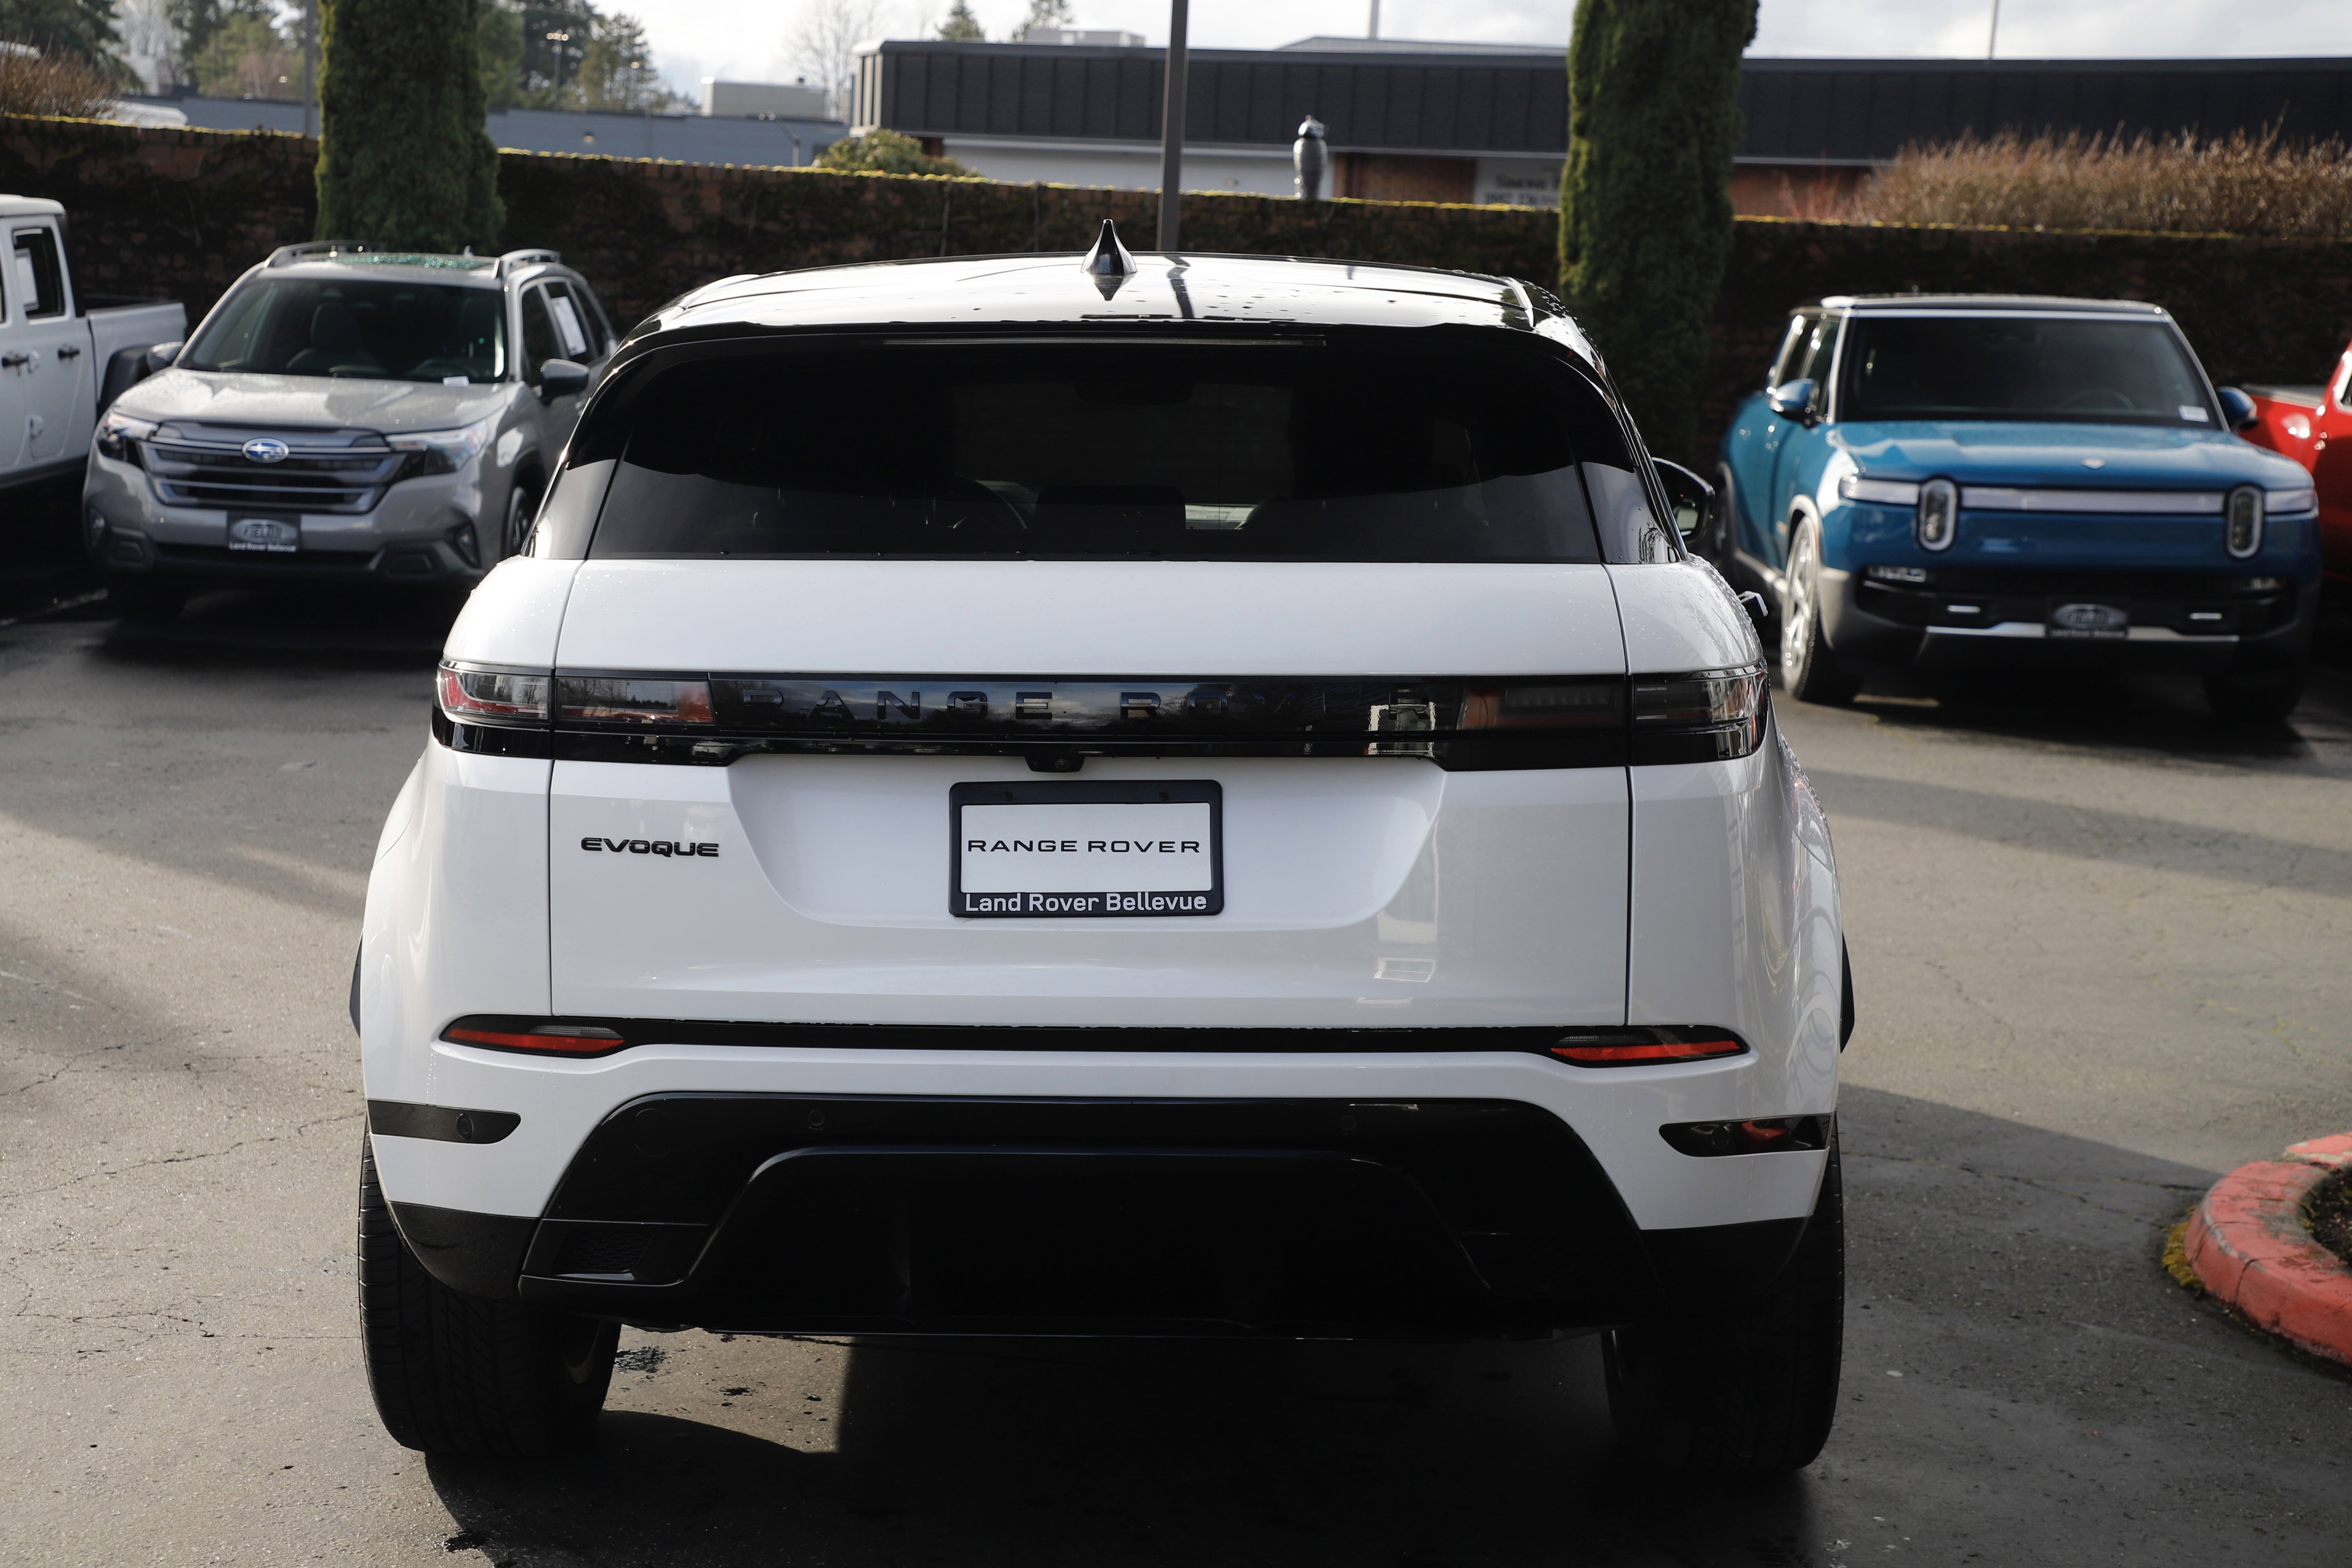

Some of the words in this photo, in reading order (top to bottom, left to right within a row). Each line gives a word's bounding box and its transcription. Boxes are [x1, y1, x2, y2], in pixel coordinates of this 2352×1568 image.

[743, 689, 1053, 720] RANGE
[1120, 691, 1430, 720] ROVER
[581, 837, 719, 858] EVOQUE
[967, 840, 1078, 852] RANGE
[1088, 841, 1200, 853] ROVER
[965, 893, 1021, 912] Land
[1028, 893, 1099, 912] Rover
[1106, 892, 1207, 911] Bellevue
